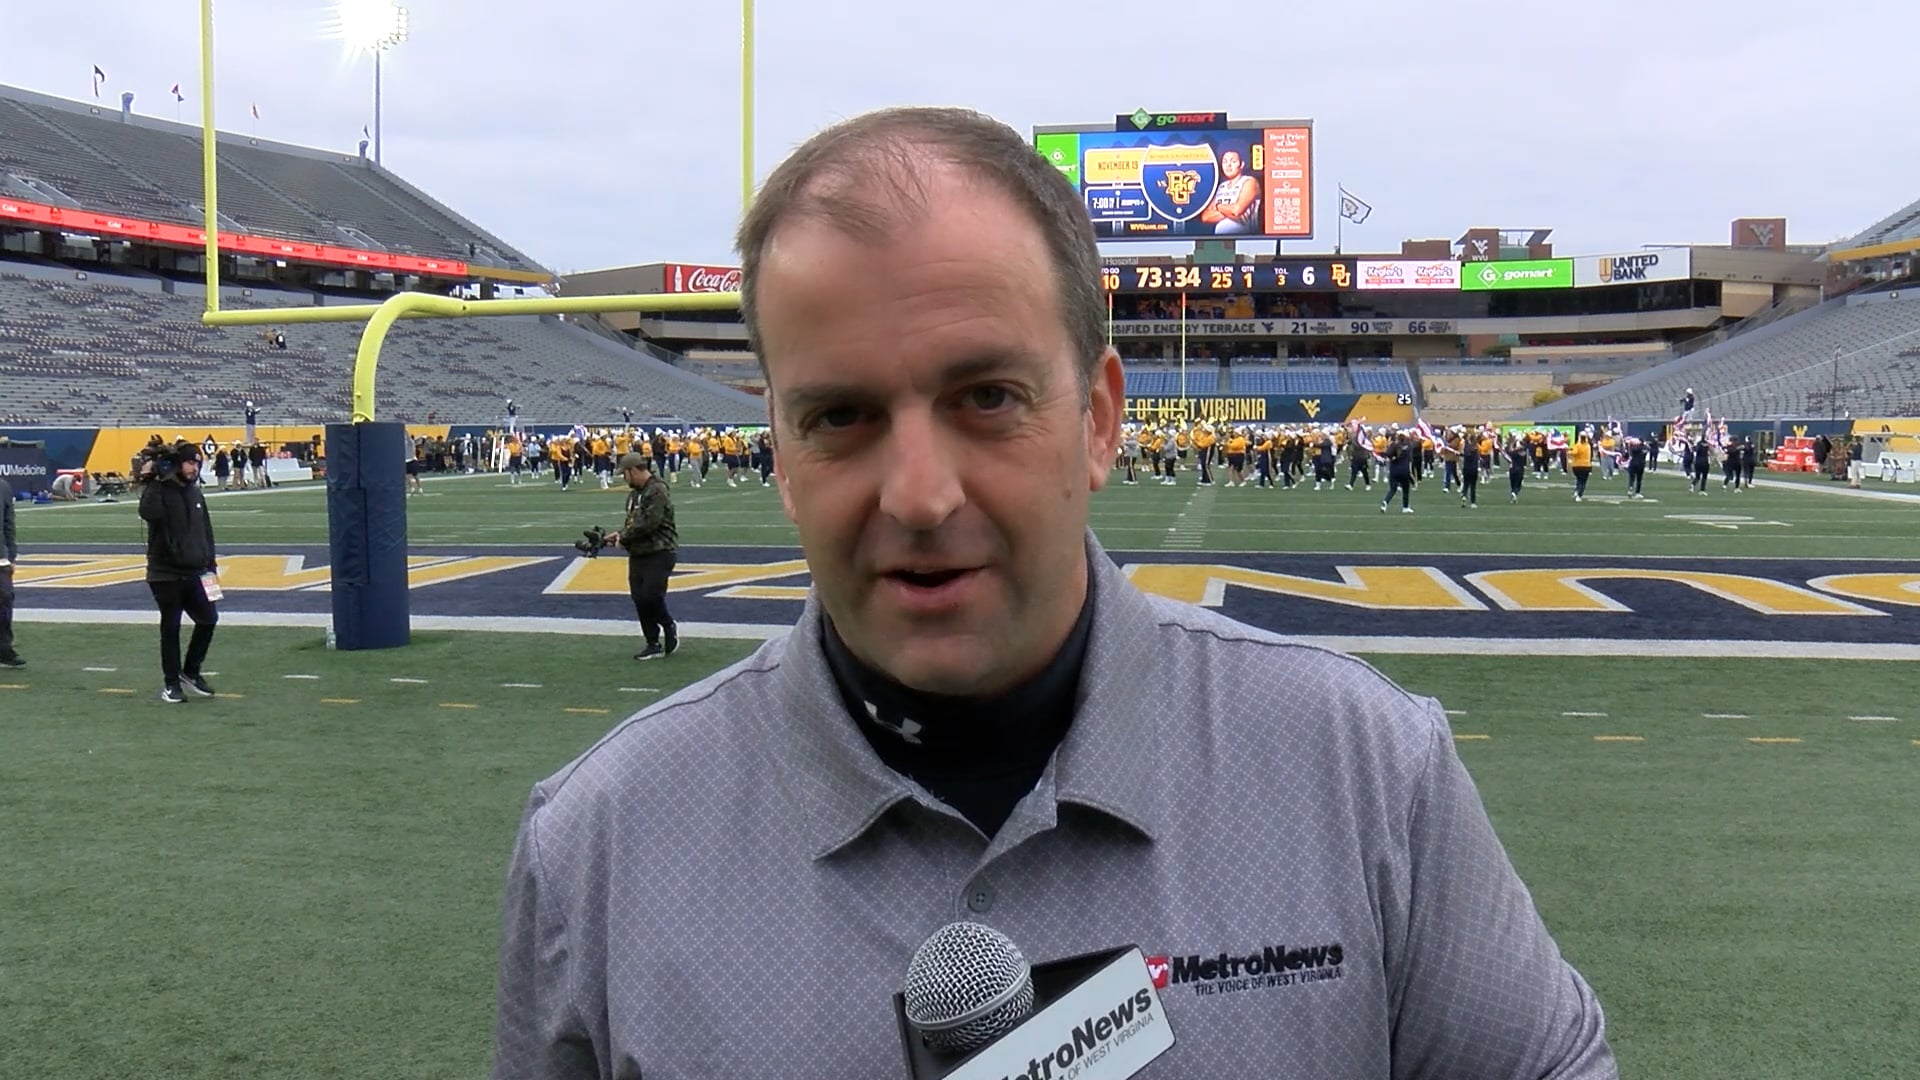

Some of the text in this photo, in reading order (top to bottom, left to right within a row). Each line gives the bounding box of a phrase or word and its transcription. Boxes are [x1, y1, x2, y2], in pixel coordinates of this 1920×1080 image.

[1156, 112, 1216, 126] gomart
[1098, 161, 1129, 171] NOVEMBER
[1105, 257, 1139, 266] Hospital
[1613, 255, 1658, 269] UNITED
[1136, 266, 1202, 288] 73:34
[1302, 266, 1316, 286] 6
[1367, 265, 1403, 277] Kegler's
[1417, 265, 1453, 277] Kegler's
[1504, 267, 1554, 280] gomart
[1613, 268, 1646, 281] BANK
[1103, 274, 1120, 290] 10
[1212, 273, 1233, 289] 25
[1244, 273, 1252, 288] 1
[1277, 275, 1286, 286] 3
[1153, 324, 1199, 334] ENERGY
[1202, 323, 1256, 333] TERRACE
[1291, 322, 1307, 333] 21
[1351, 321, 1369, 333] 90
[1408, 321, 1427, 333] 66
[1397, 393, 1412, 405] 25
[1137, 398, 1155, 420] OF
[1158, 398, 1197, 420] WEST
[1200, 398, 1266, 420] VIRGINIA
[1172, 943, 1344, 984] MetroNews
[1195, 966, 1341, 996] THE VOICE OF WEST VIRGINIA
[1067, 1012, 1154, 1080] OF WEST VIRGINIA
